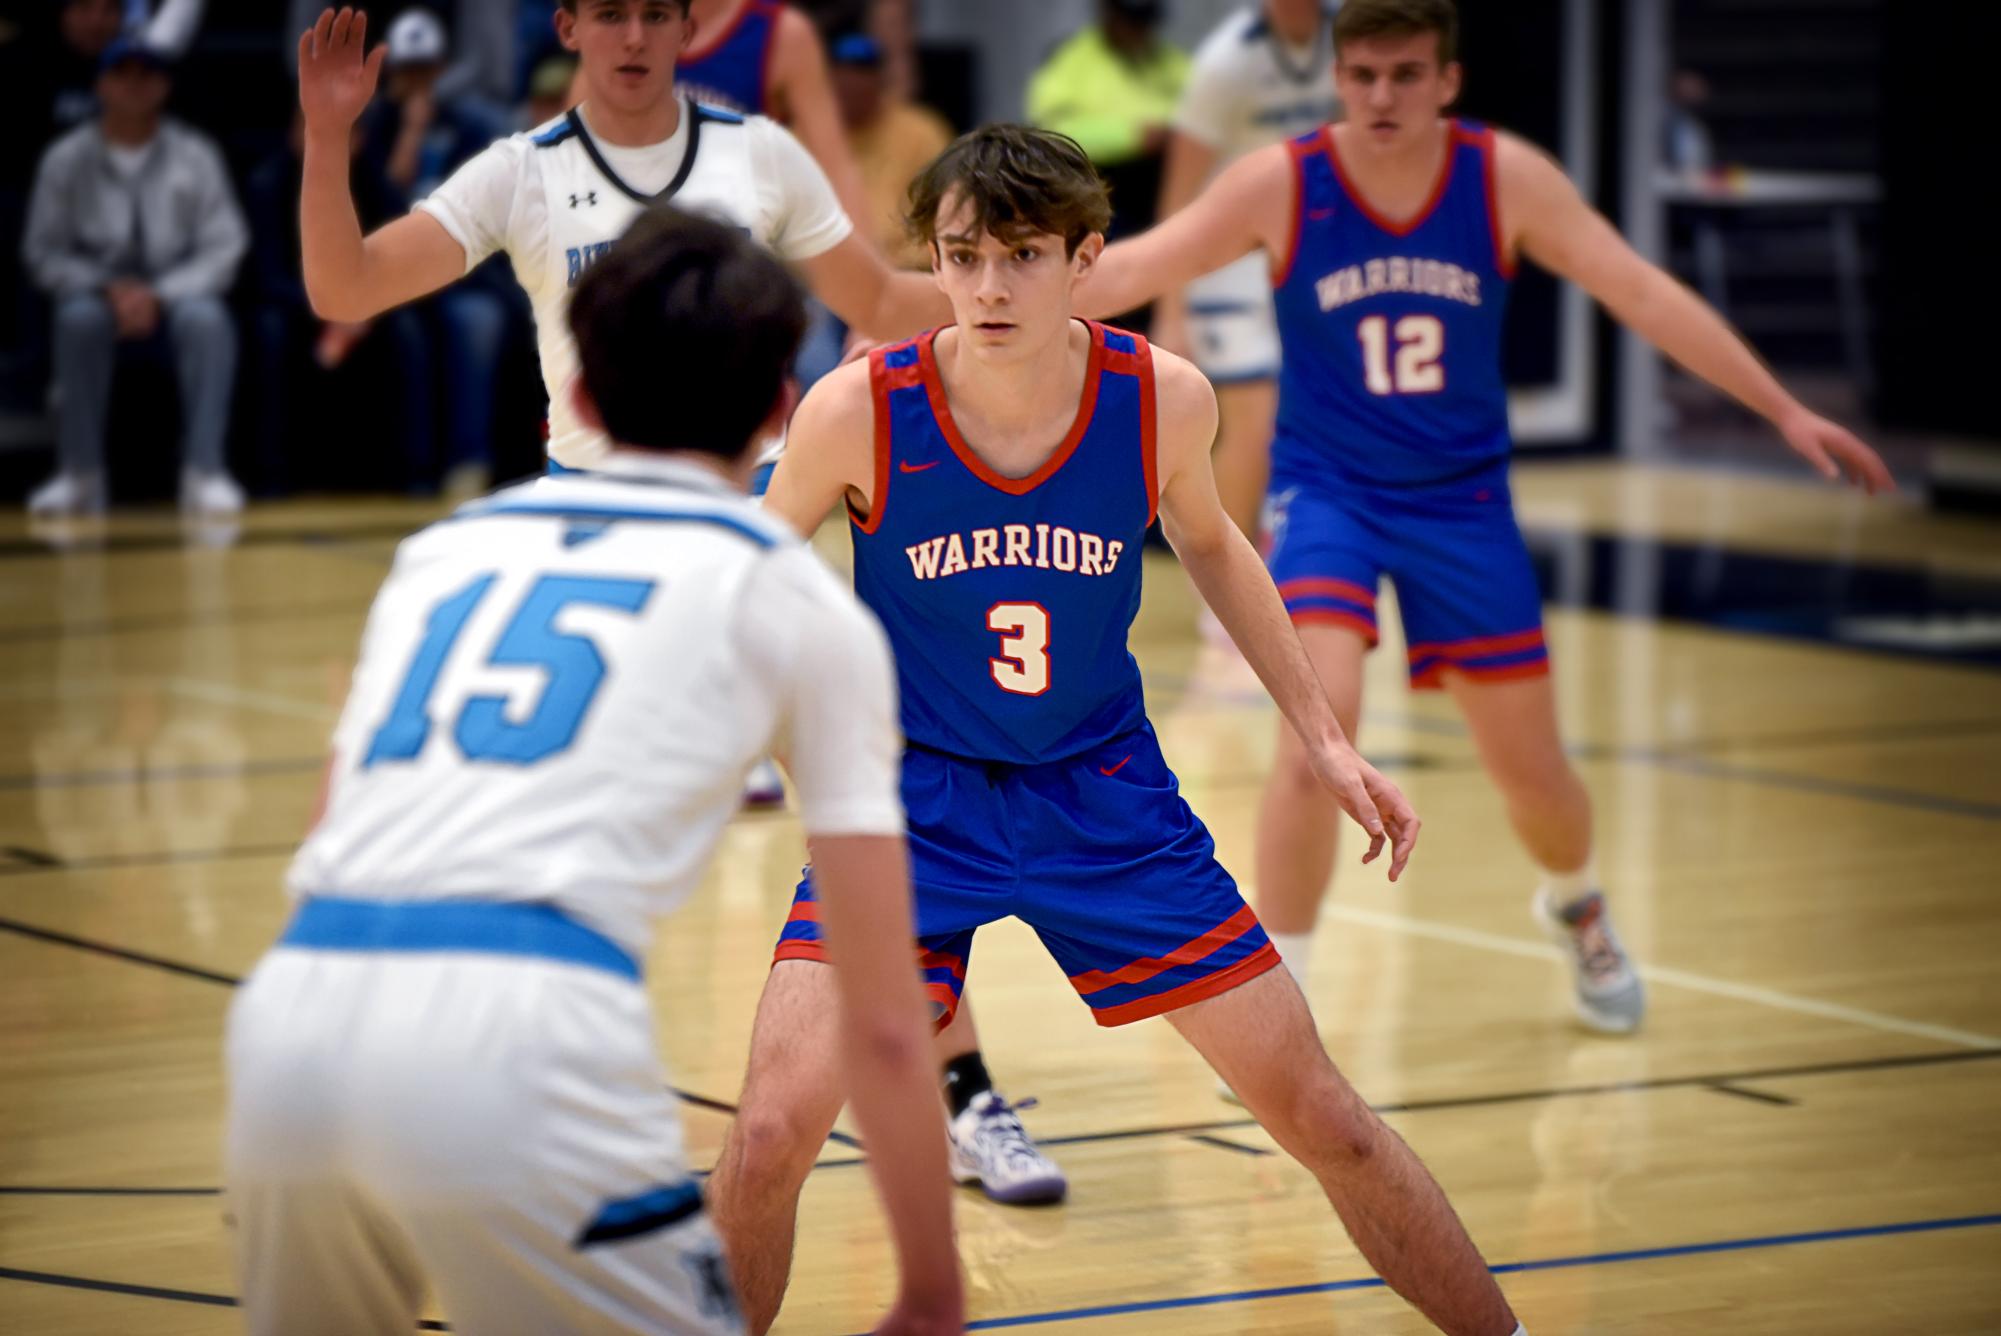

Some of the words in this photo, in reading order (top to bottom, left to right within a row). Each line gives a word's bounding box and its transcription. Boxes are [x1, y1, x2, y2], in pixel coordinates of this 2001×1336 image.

[1314, 256, 1482, 313] WARRIORS
[1357, 314, 1445, 395] 12
[905, 523, 1124, 580] WARRIORS
[361, 571, 657, 768] 15
[986, 601, 1051, 697] 3
